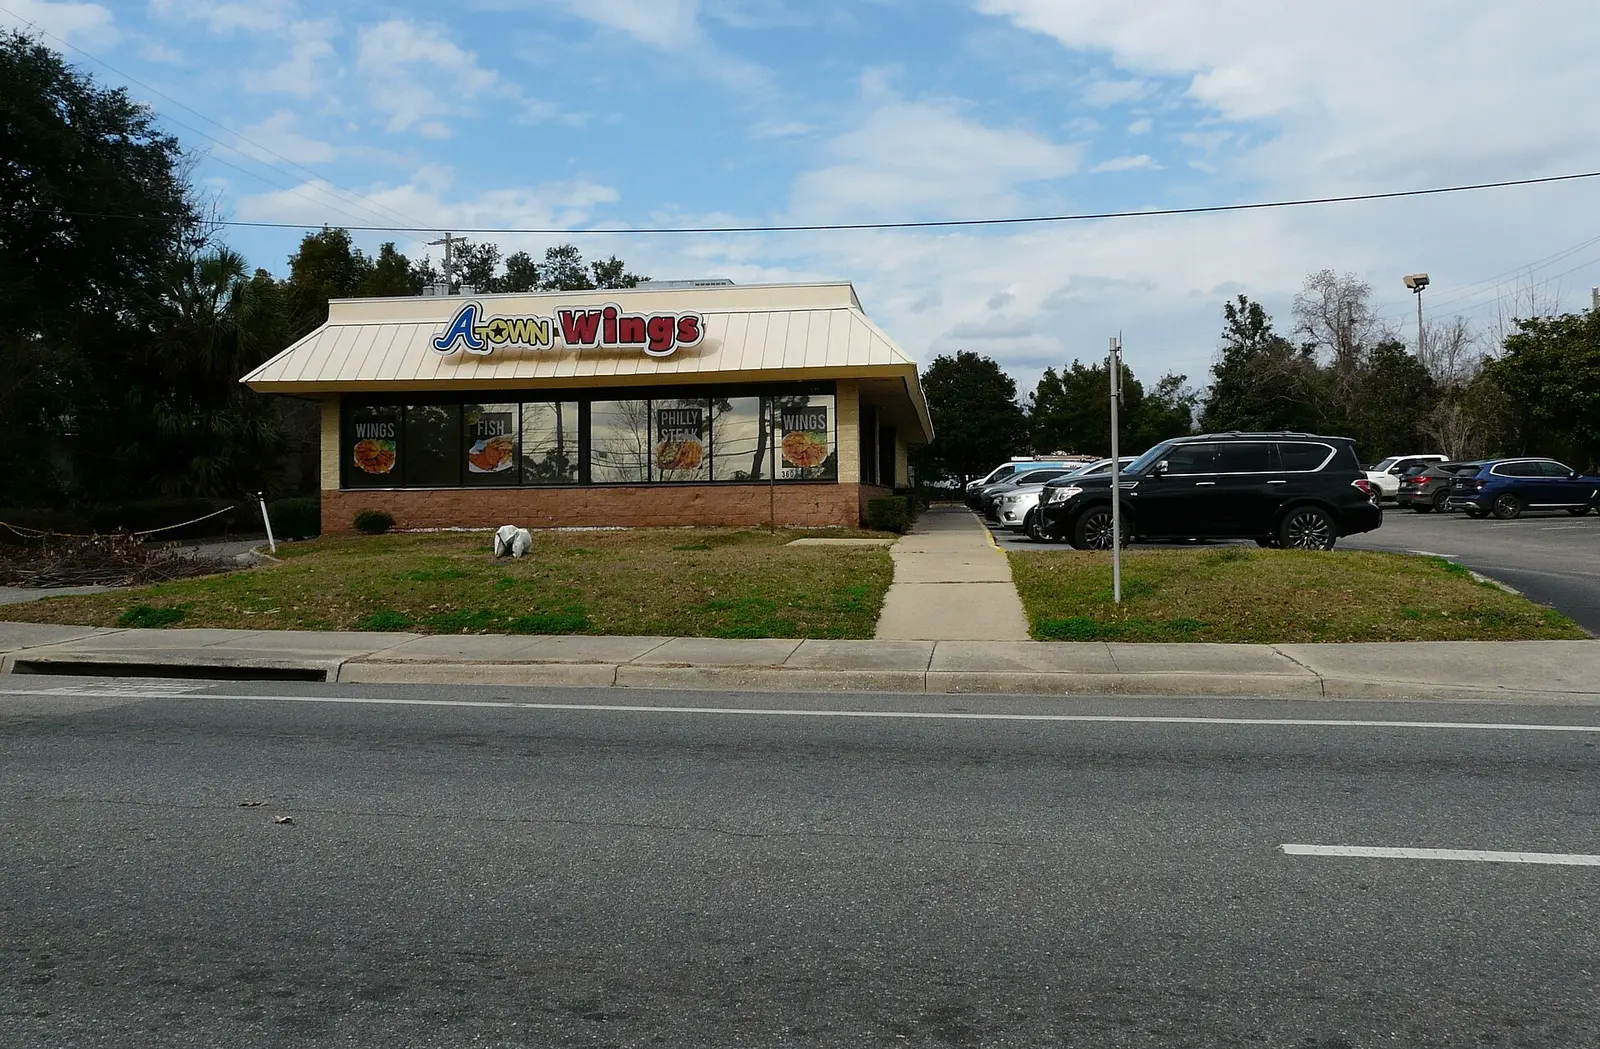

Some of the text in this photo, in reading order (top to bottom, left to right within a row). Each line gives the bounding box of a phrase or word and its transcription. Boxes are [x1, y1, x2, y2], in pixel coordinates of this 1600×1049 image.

[558, 306, 699, 353] Wings
[661, 411, 698, 425] PHILLY
[782, 414, 826, 430] WINGS
[355, 422, 395, 438] WINGS
[477, 420, 505, 436] FISH
[661, 428, 698, 443] STEAK
